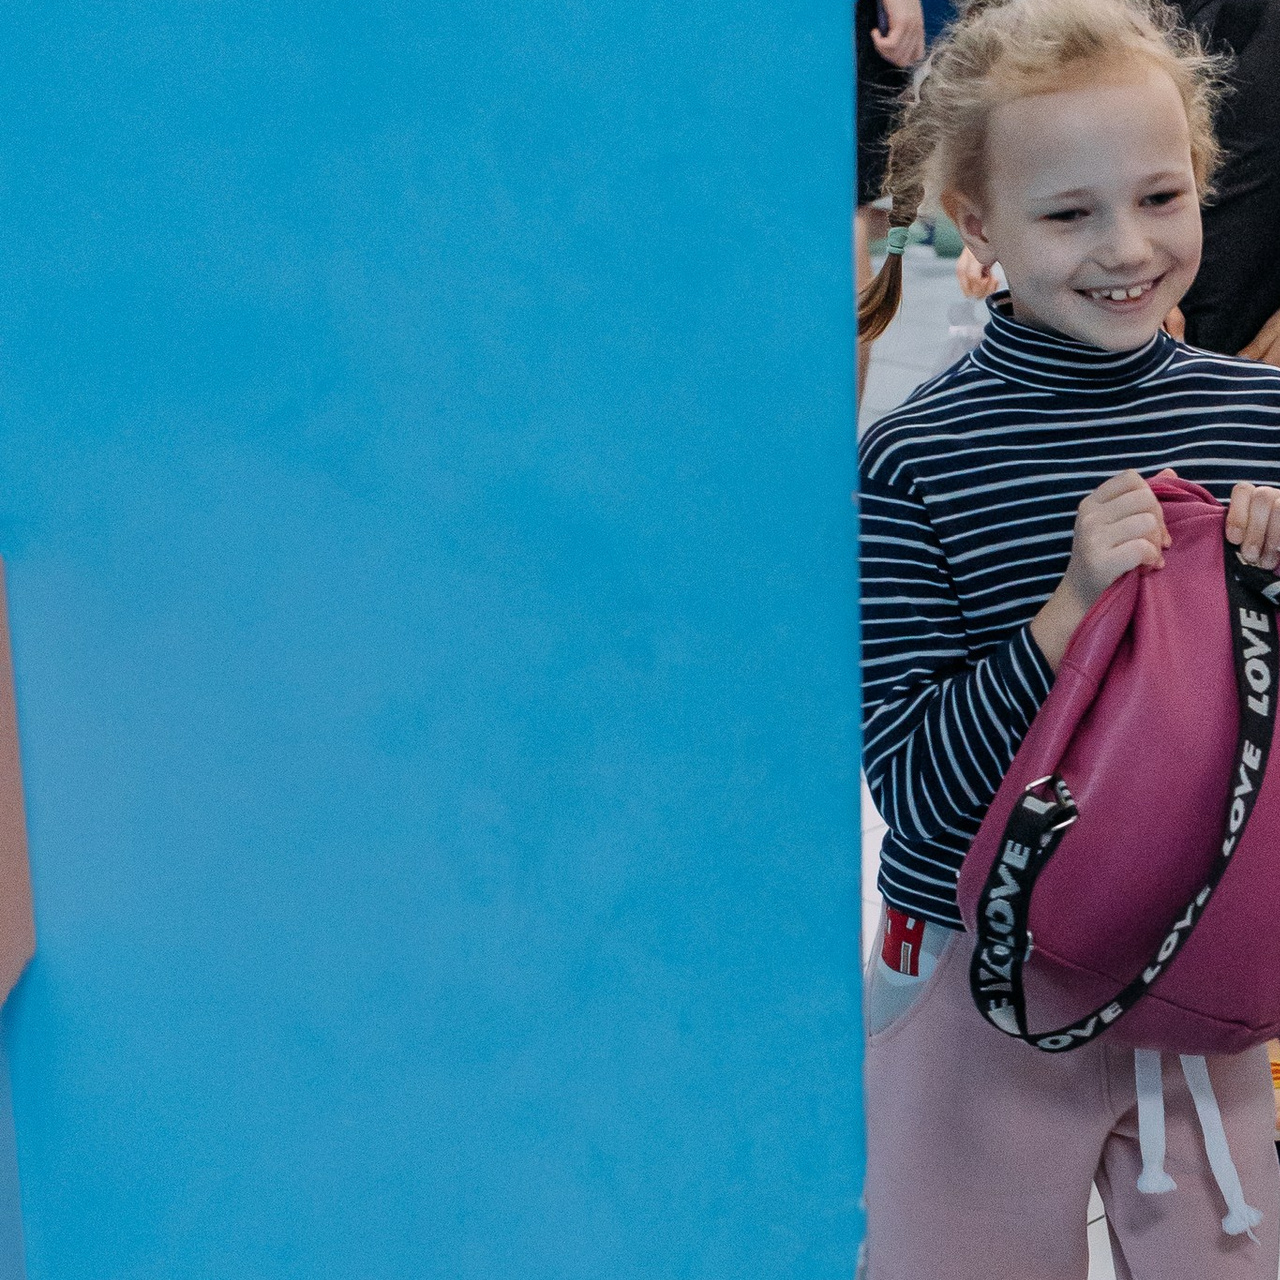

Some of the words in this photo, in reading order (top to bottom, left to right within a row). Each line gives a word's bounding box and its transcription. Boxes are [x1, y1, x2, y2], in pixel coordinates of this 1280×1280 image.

[1239, 607, 1272, 717] LOVE
[1222, 740, 1262, 857] LOVE
[1036, 1001, 1123, 1050] OVE
